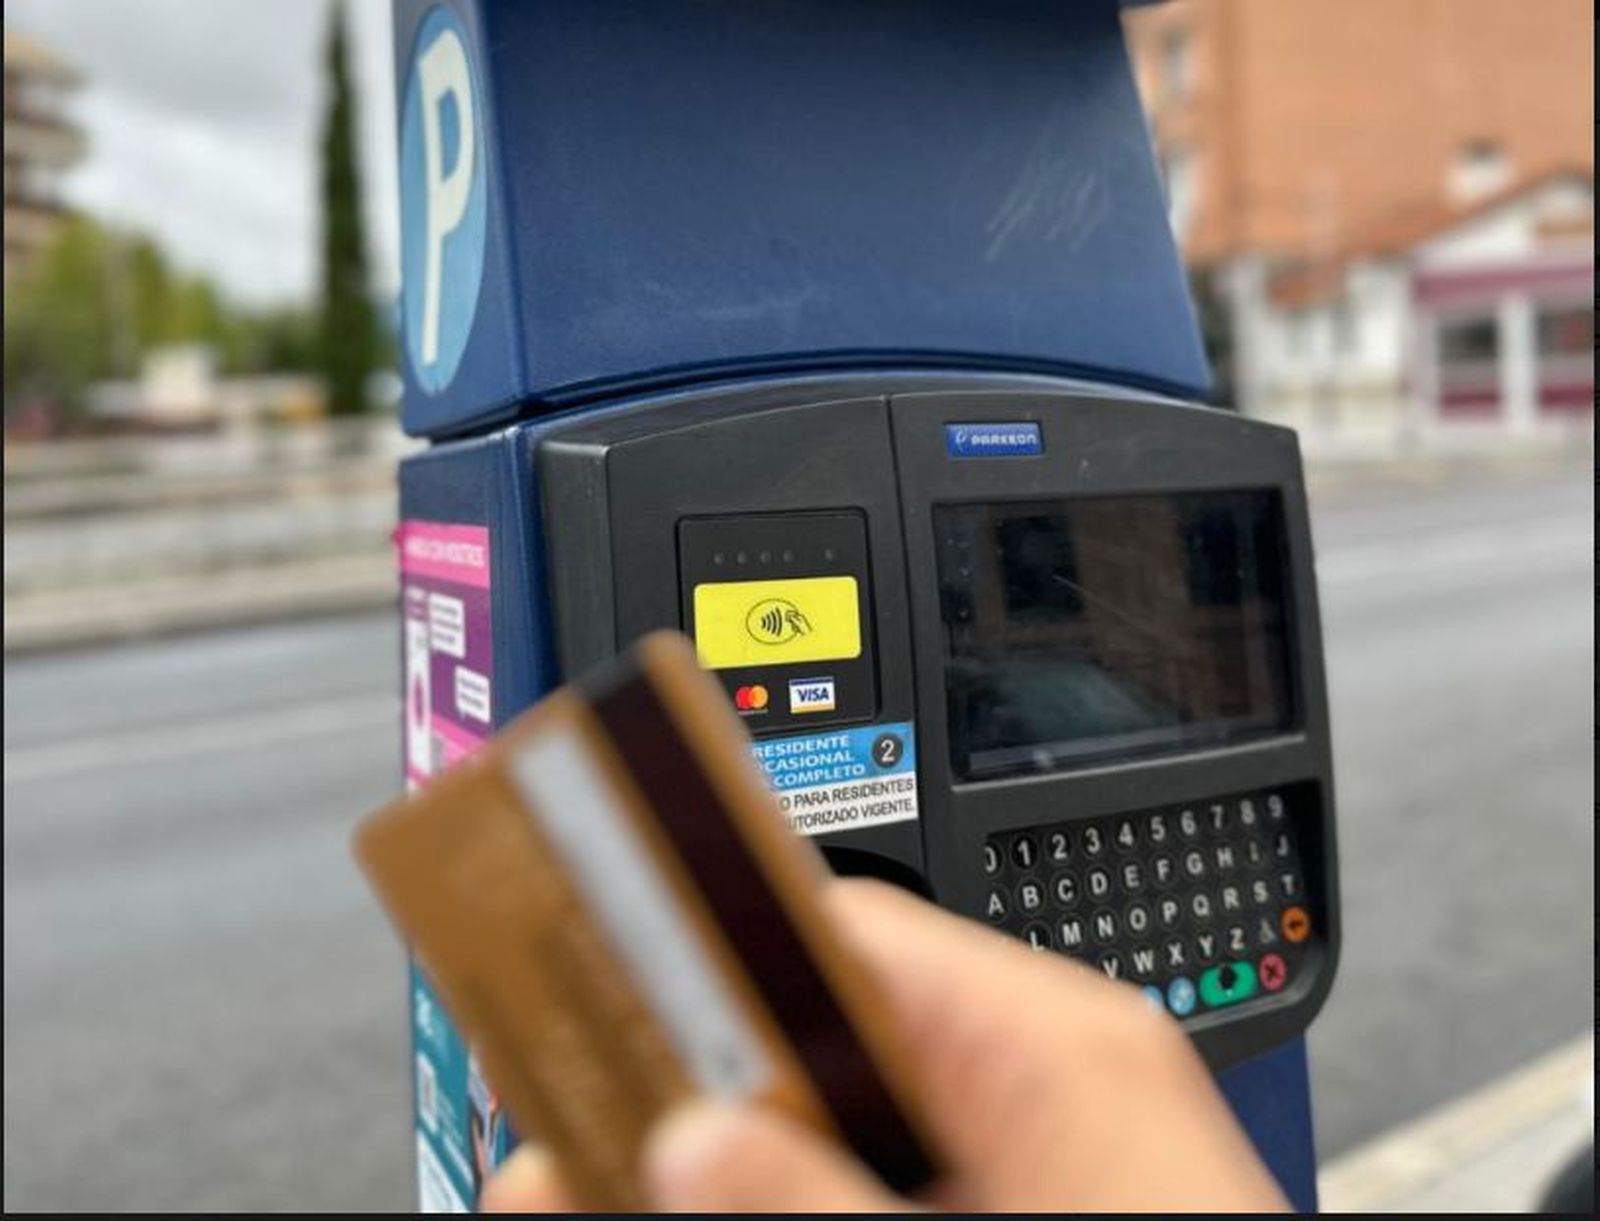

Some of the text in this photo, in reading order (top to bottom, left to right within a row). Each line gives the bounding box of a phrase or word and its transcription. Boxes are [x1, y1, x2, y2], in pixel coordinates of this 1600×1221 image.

[419, 29, 474, 365] P
[797, 687, 830, 703] VISA
[752, 735, 849, 758] RESIDENTE
[881, 739, 896, 763] 2
[773, 764, 865, 788] COMPLETO
[794, 790, 830, 809] PARA
[831, 778, 914, 804] RESIDENTES
[786, 806, 858, 829] UTORIZADO
[1017, 840, 1031, 865] 1
[1051, 834, 1067, 859] 2
[1086, 828, 1100, 853] 3
[1118, 823, 1134, 846] 4
[1151, 816, 1165, 840] 5
[1181, 811, 1196, 835] 6
[1210, 806, 1223, 828] 7
[1240, 801, 1255, 824] 8
[1268, 795, 1283, 818] 9
[988, 893, 1005, 915] A
[1022, 885, 1039, 909] B
[1057, 878, 1074, 901] C
[1091, 873, 1107, 895] D
[1124, 866, 1139, 887] E
[1157, 860, 1169, 881] F
[1186, 853, 1203, 874] G
[1217, 849, 1232, 868] H
[1062, 922, 1082, 946] M
[1098, 916, 1113, 937] N
[1129, 908, 1147, 930] O
[1162, 902, 1177, 923] P
[1193, 896, 1210, 917] Q
[1223, 888, 1239, 908] R
[1254, 881, 1267, 901] S
[1103, 928, 1244, 979] V W X Y Z
